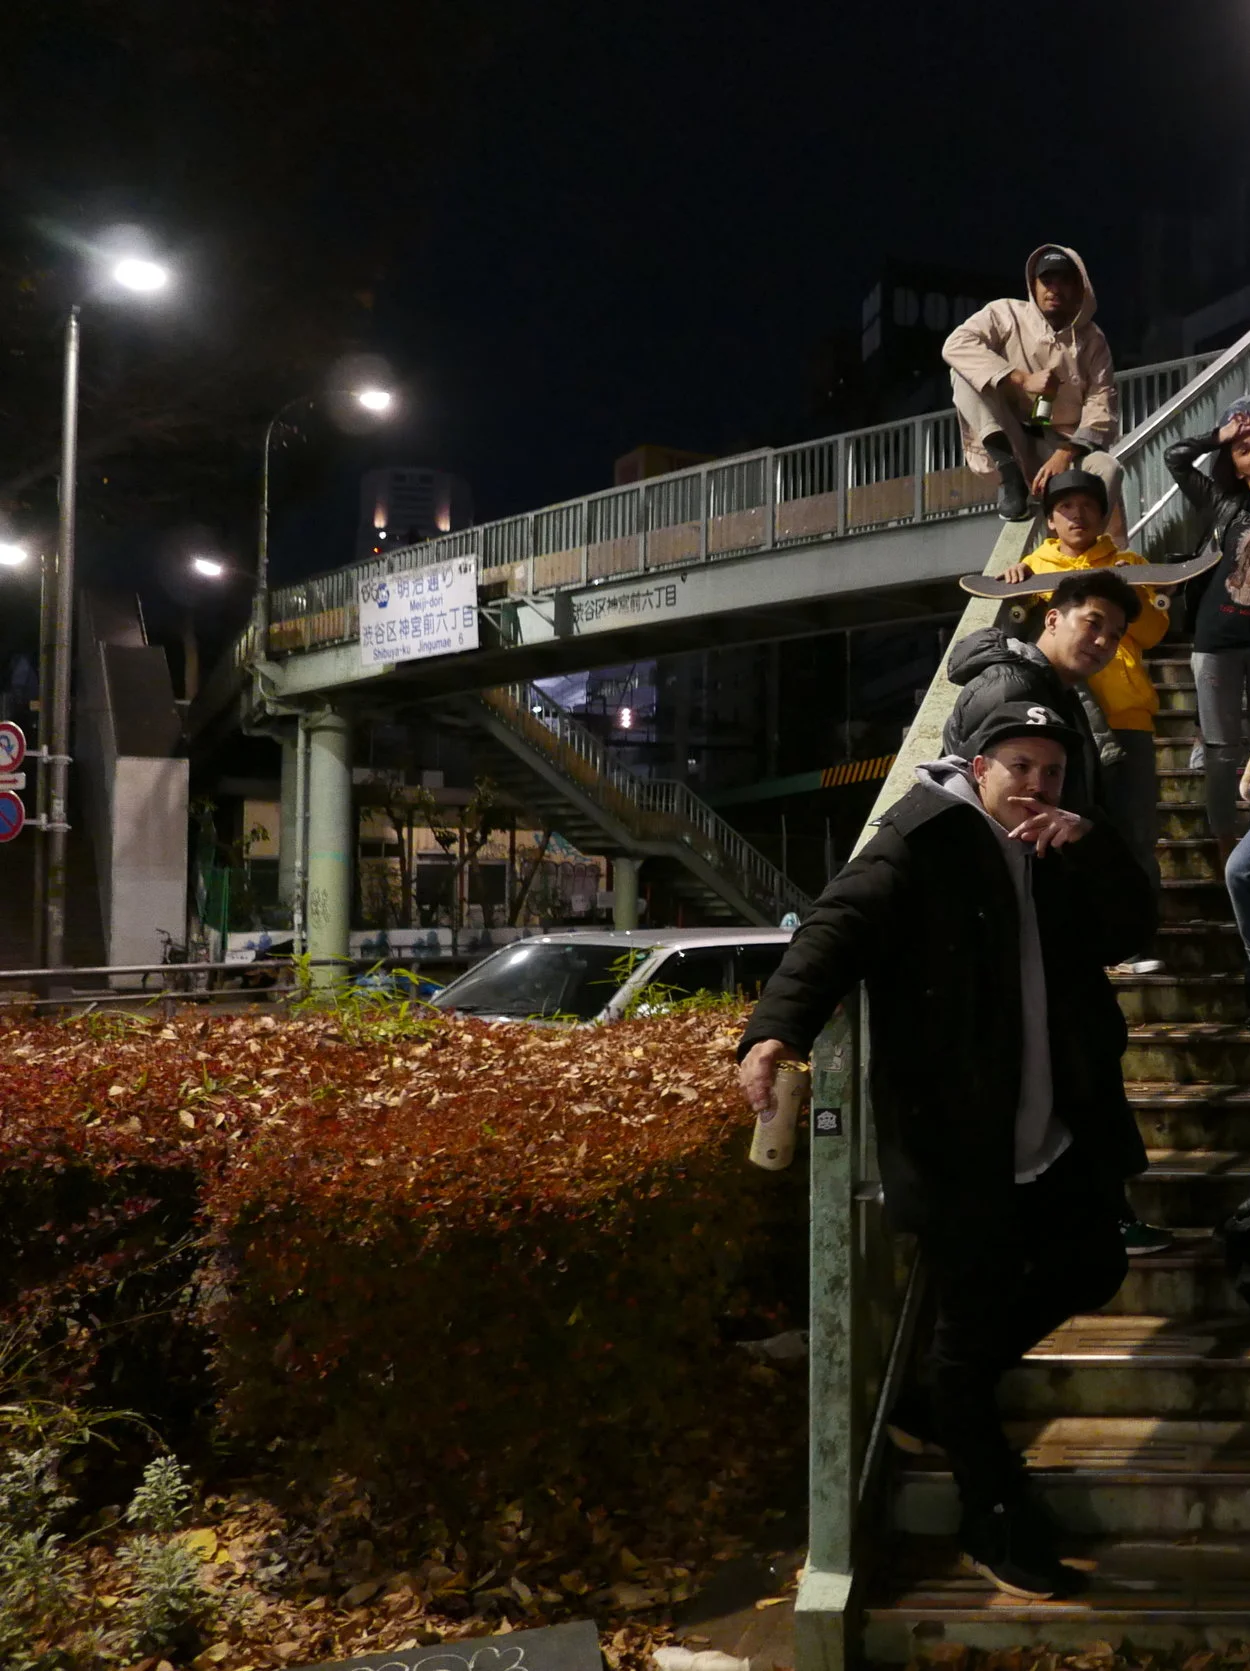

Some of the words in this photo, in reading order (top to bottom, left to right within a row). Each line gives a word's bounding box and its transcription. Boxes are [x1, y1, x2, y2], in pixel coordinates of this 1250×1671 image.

[397, 566, 454, 598] 明治通り
[363, 605, 474, 647] 渋谷区神宮前六丁目
[1026, 706, 1048, 725] S
